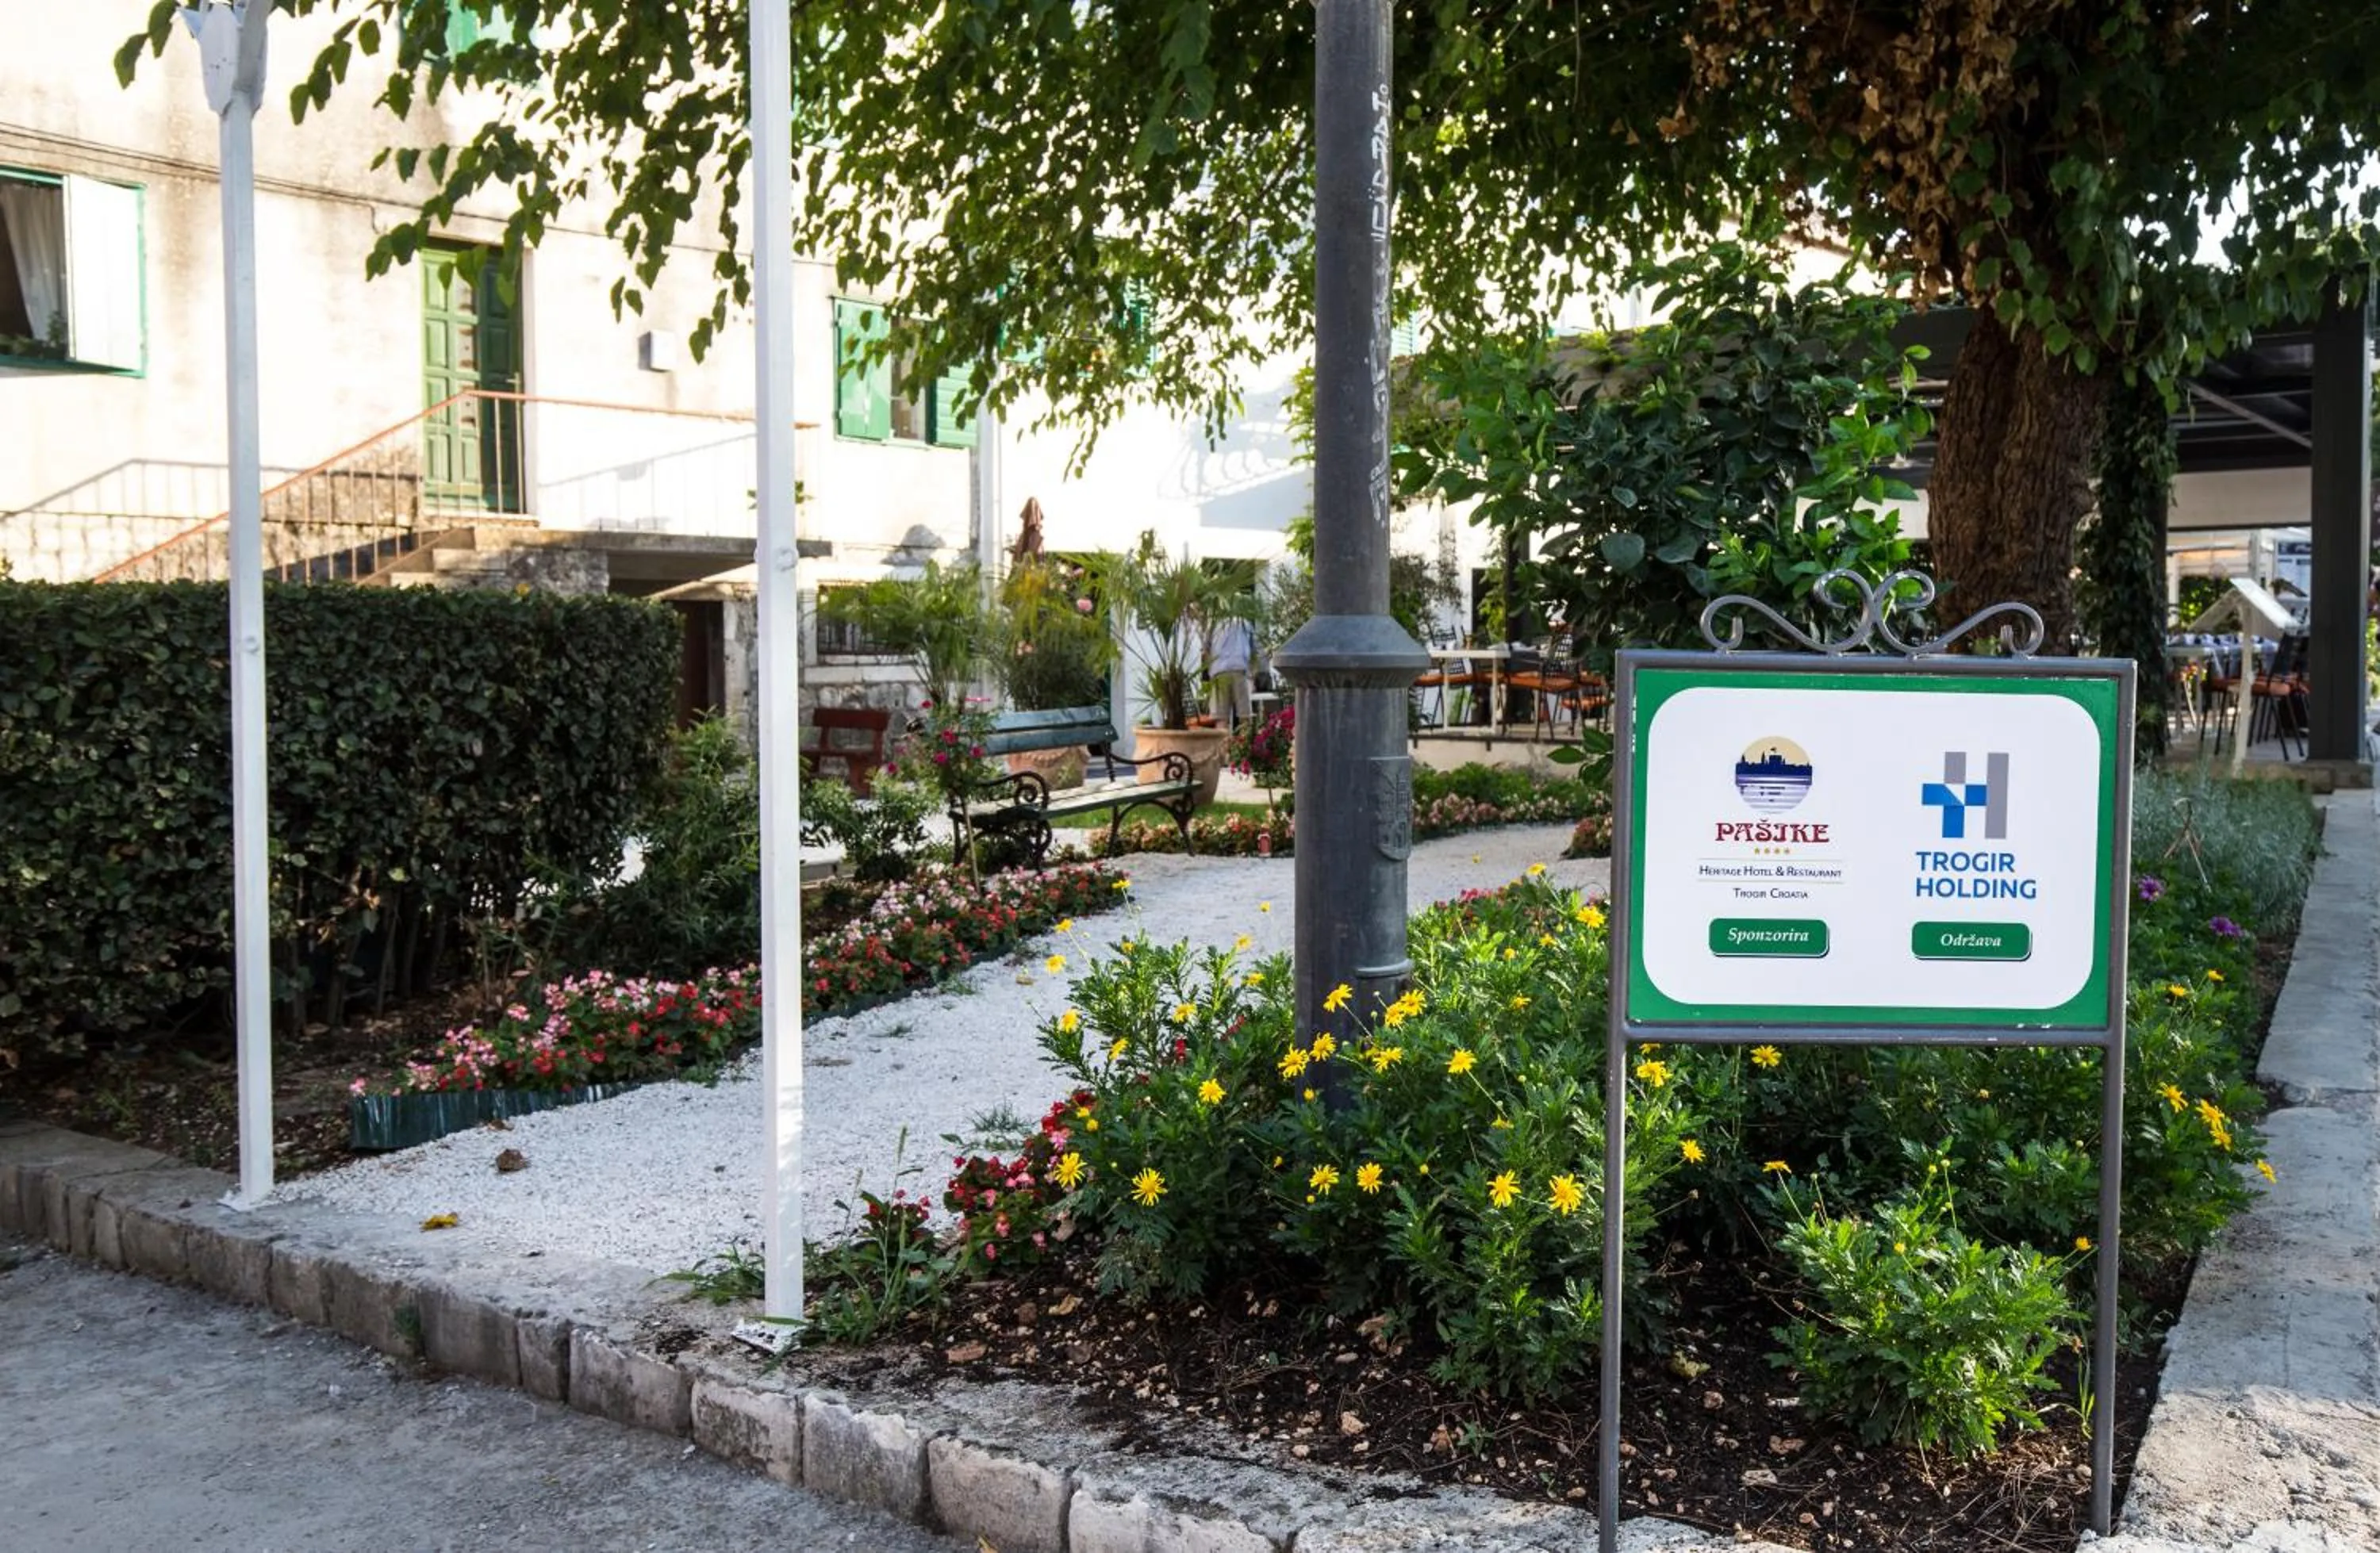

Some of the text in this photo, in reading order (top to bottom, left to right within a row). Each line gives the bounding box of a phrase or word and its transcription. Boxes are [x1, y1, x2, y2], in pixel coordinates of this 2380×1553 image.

[1915, 851, 2015, 872] TROGIR
[1744, 866, 1773, 876] HOTEL
[1775, 866, 1784, 876] &
[1786, 866, 1841, 878] RESTAURANT
[1916, 877, 2036, 899] HOLDING
[1728, 927, 1809, 945] Sponzorira
[1940, 933, 2001, 946] Održava
